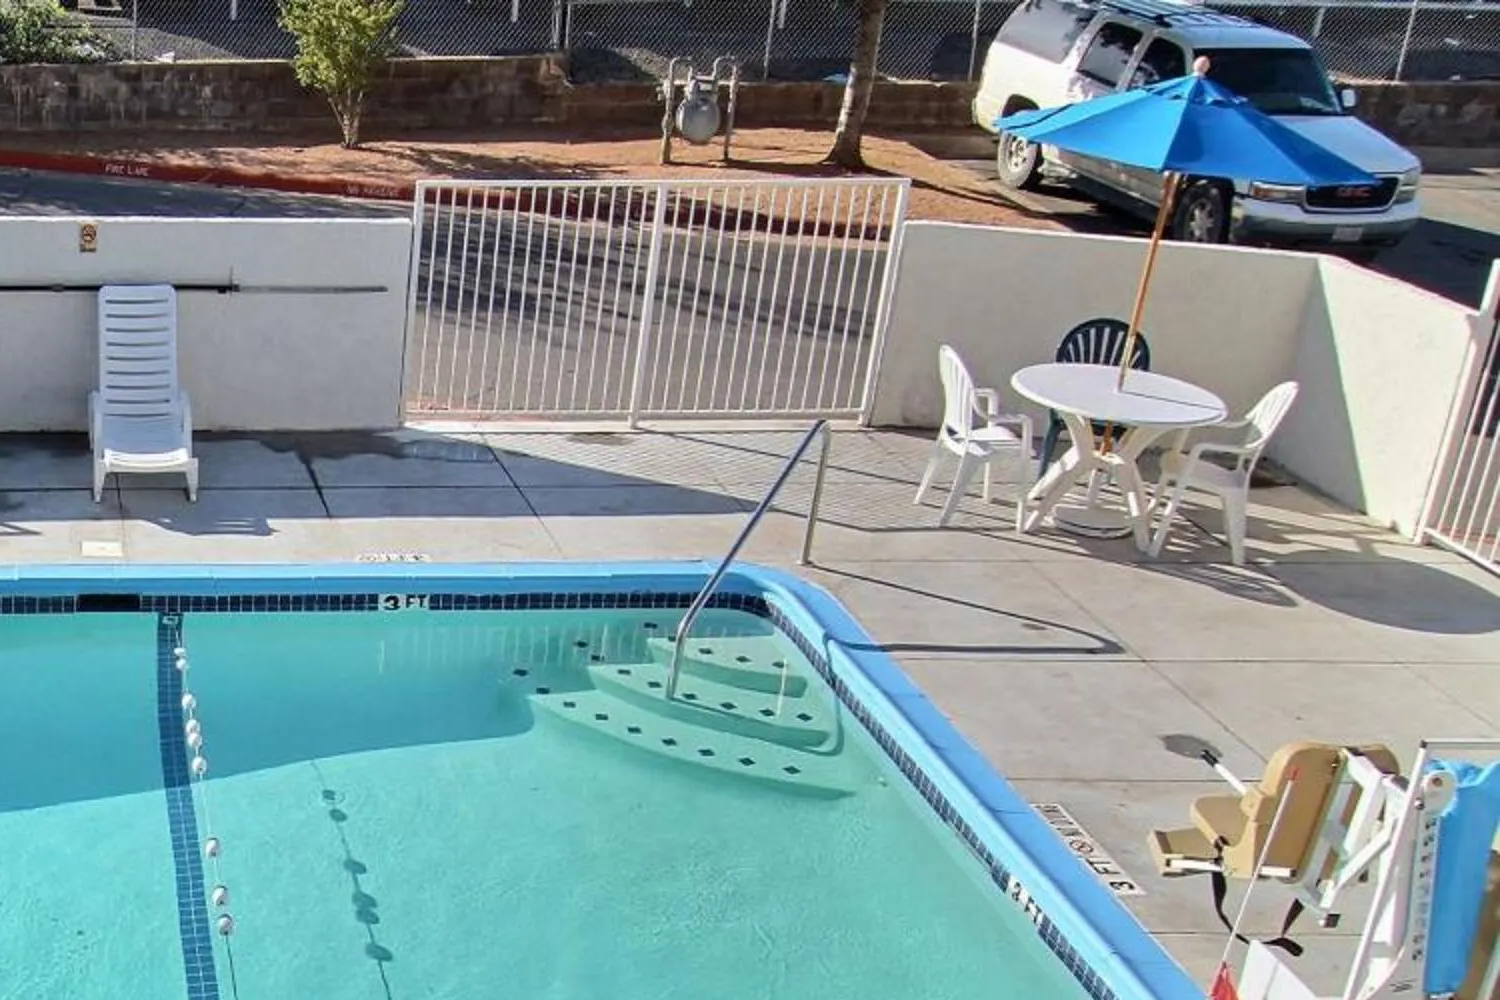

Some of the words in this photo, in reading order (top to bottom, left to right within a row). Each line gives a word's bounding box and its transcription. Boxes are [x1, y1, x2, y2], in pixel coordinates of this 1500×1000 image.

[383, 594, 401, 610] 3
[405, 593, 427, 609] FT
[1109, 880, 1135, 891] 3
